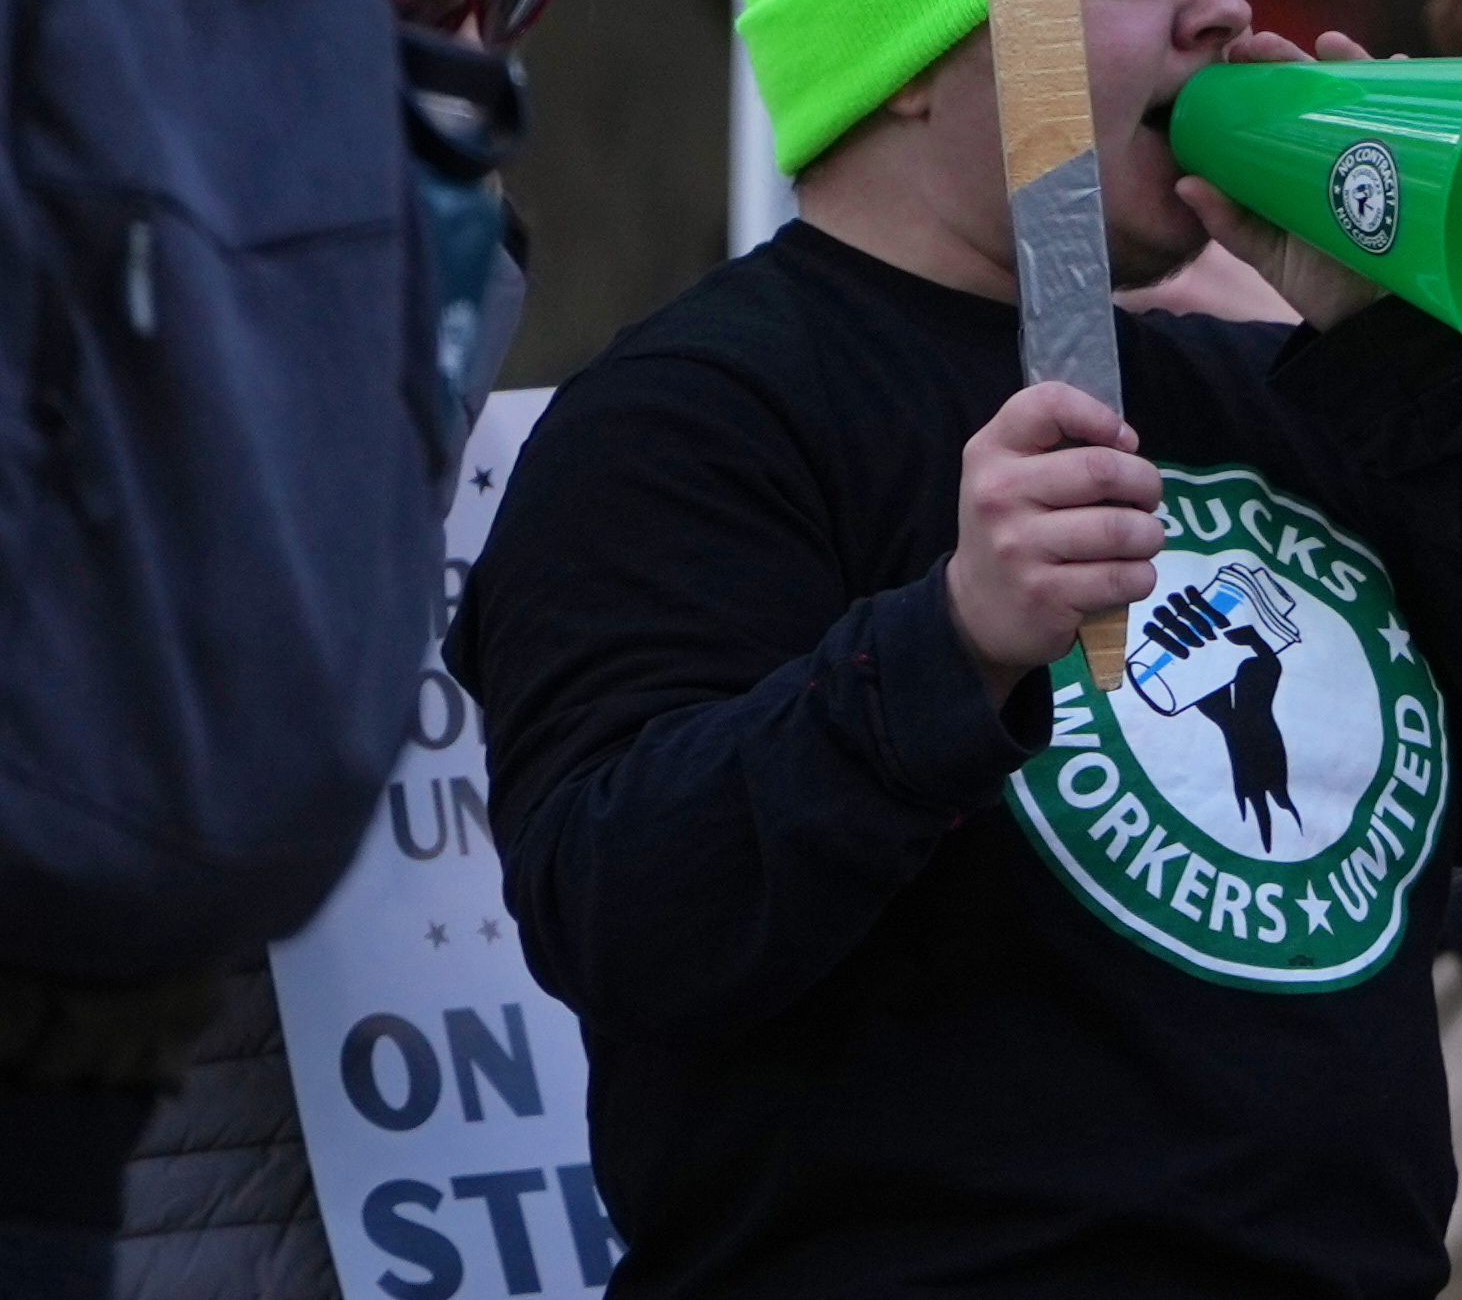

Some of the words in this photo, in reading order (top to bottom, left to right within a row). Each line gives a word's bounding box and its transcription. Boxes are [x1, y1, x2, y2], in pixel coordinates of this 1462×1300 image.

[1049, 681, 1288, 943] WORKERS
[1327, 694, 1432, 921] UNITED
[339, 1001, 546, 1133] ON
